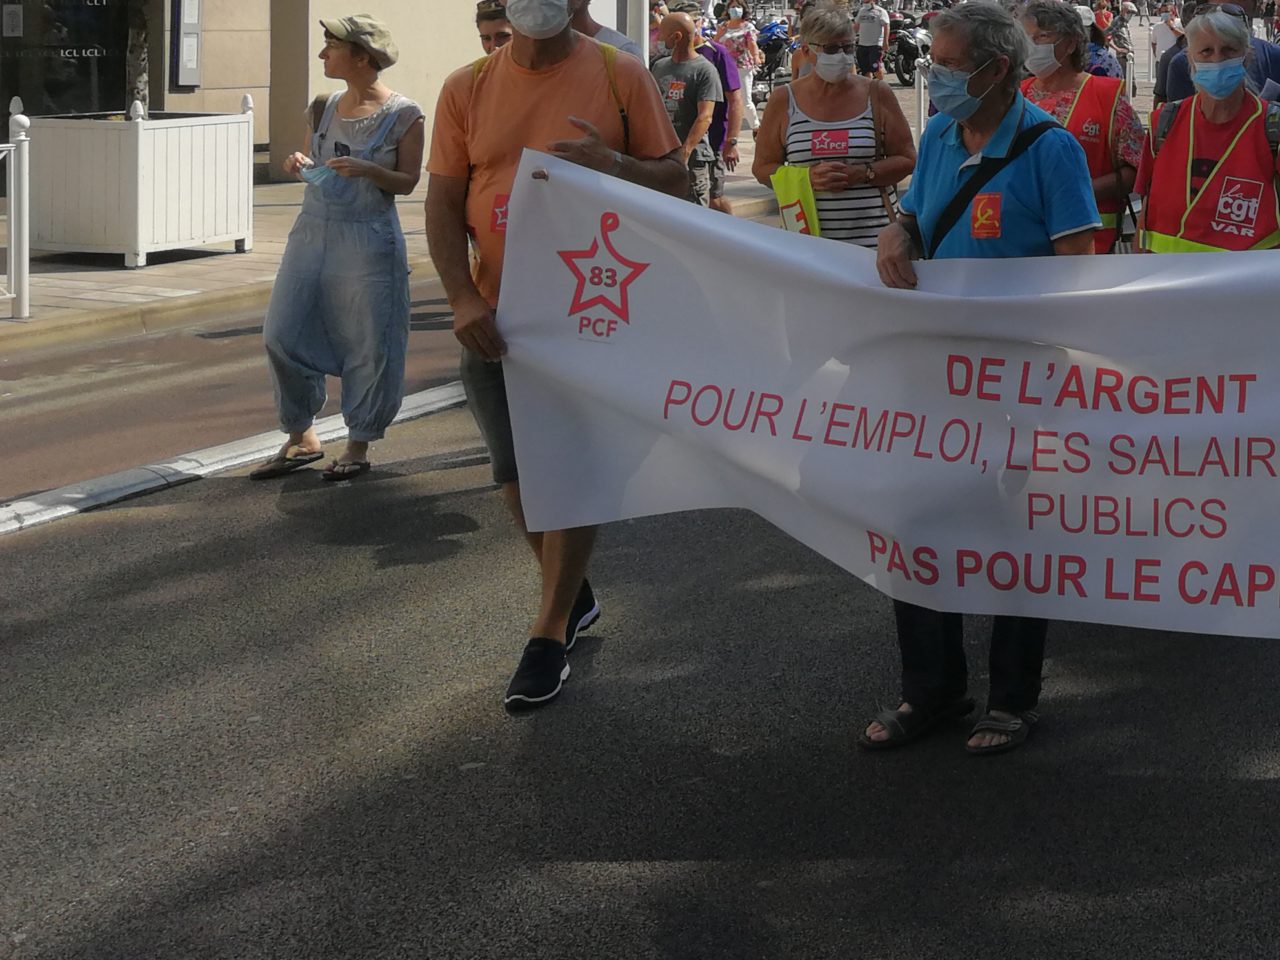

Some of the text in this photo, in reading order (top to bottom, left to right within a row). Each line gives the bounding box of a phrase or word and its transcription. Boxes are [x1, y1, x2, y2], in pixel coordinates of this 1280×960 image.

[60, 48, 101, 57] LCL LCL
[829, 142, 848, 150] PCF
[1218, 197, 1260, 222] cgt
[1210, 221, 1256, 238] VAR
[589, 265, 618, 288] 83
[578, 315, 619, 338] PCF
[946, 354, 1258, 415] DE L'ARGENT
[663, 379, 784, 437] POUR
[792, 398, 988, 474] L'EMPLOI,
[1005, 427, 1091, 473] LES
[1027, 493, 1228, 539] PUBLICS
[866, 530, 940, 586] PAS
[956, 549, 1089, 598] POUR
[1104, 557, 1161, 602] LE
